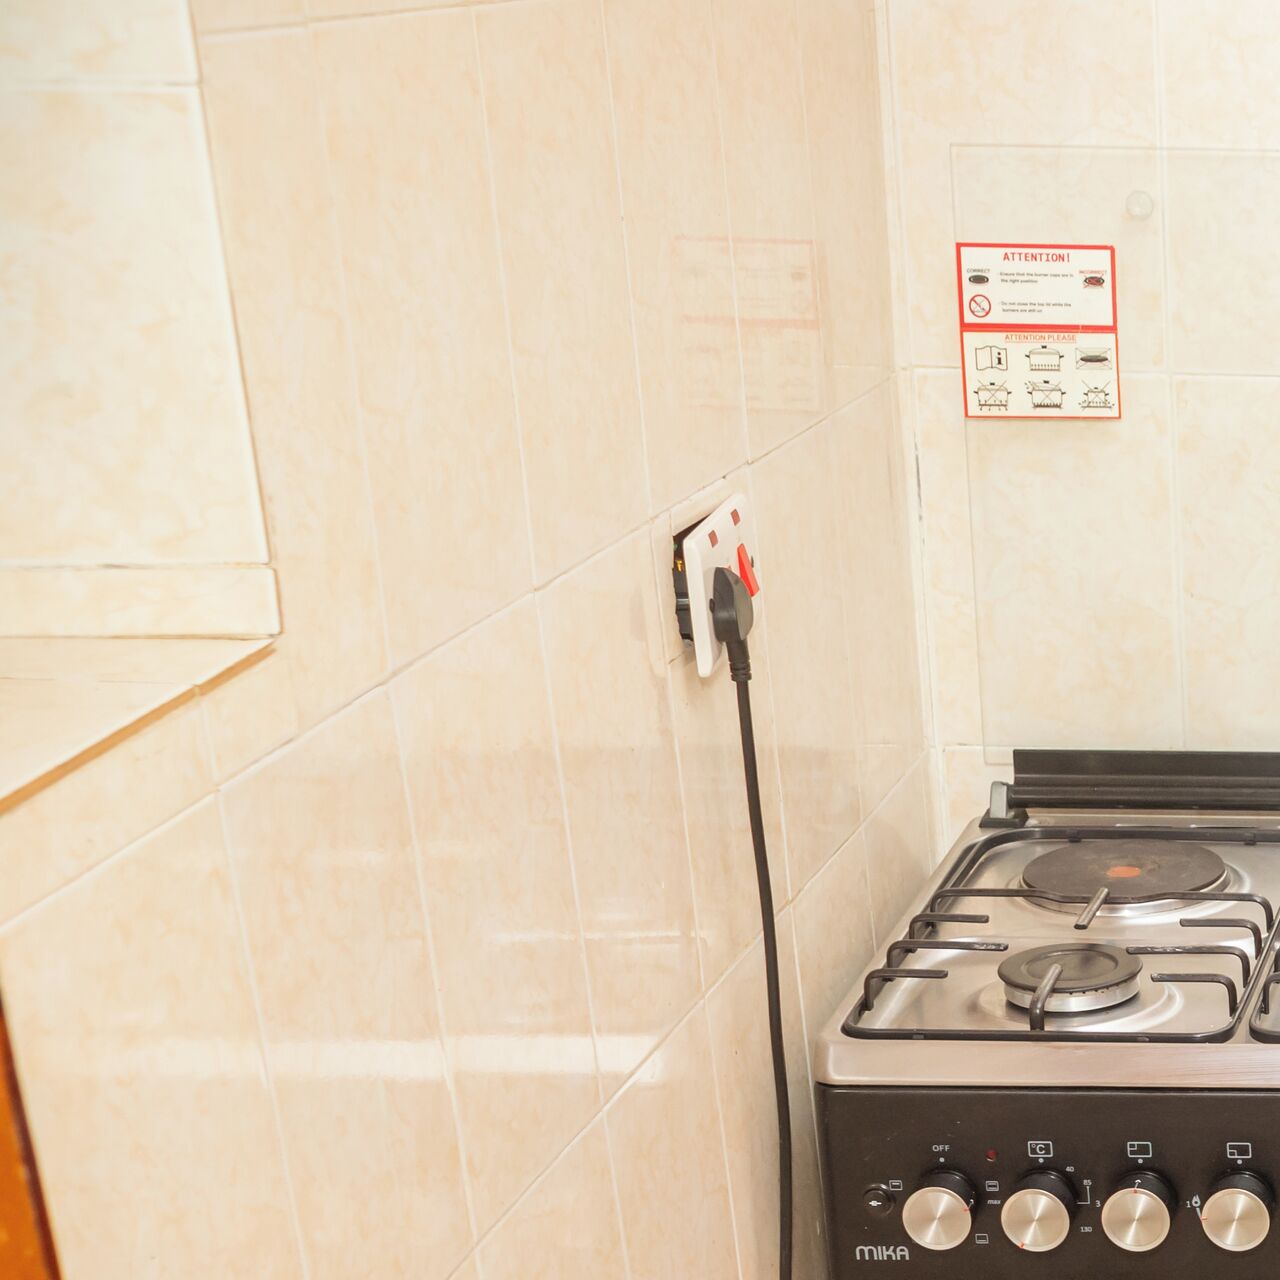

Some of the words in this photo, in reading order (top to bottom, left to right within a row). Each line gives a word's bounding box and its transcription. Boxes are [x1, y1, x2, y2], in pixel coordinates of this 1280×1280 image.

[1003, 252, 1070, 263] ATTENTION!
[932, 1144, 950, 1152] OFF
[855, 1245, 910, 1260] MIKA
